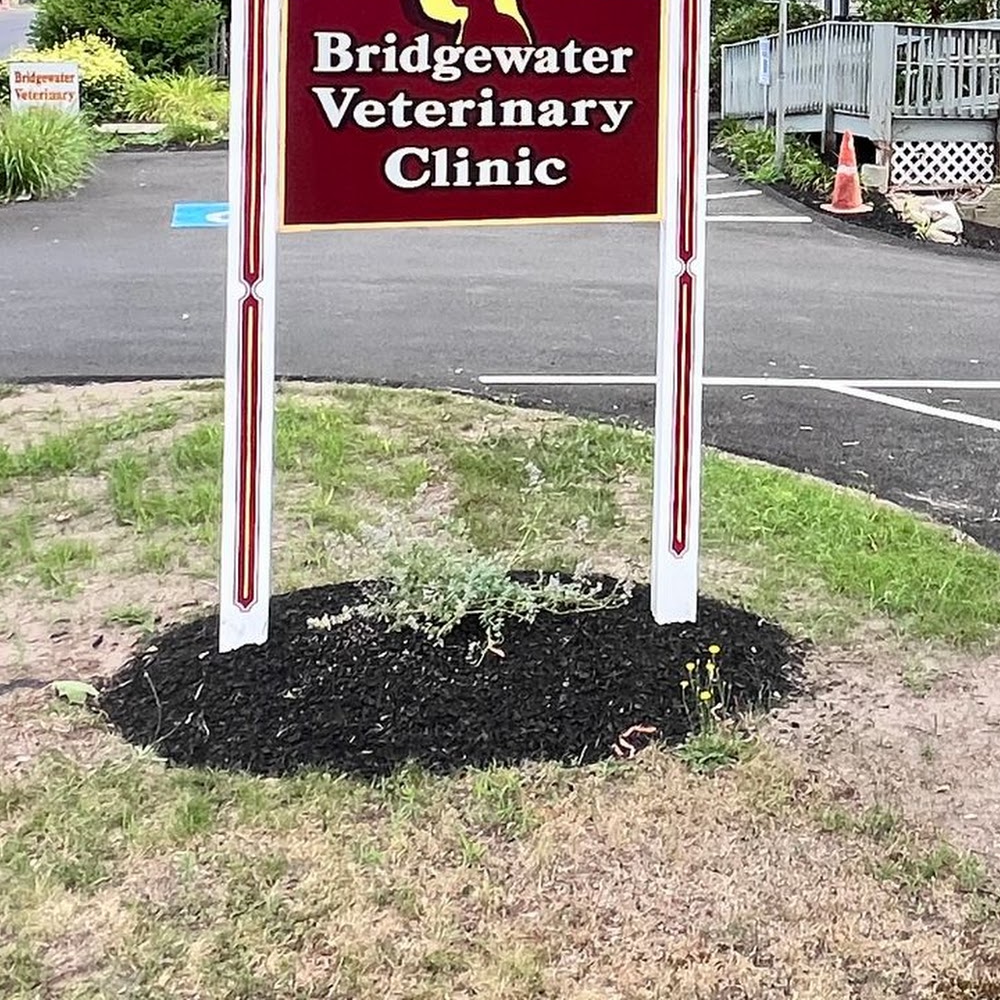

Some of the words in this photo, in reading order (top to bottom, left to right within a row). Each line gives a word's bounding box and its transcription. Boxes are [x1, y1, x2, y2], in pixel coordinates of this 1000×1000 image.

[313, 31, 633, 82] Bridgewater
[14, 71, 75, 85] Bridgewater
[15, 88, 76, 102] Veterinary
[312, 87, 633, 132] Veterinary
[384, 147, 567, 188] Clinic
